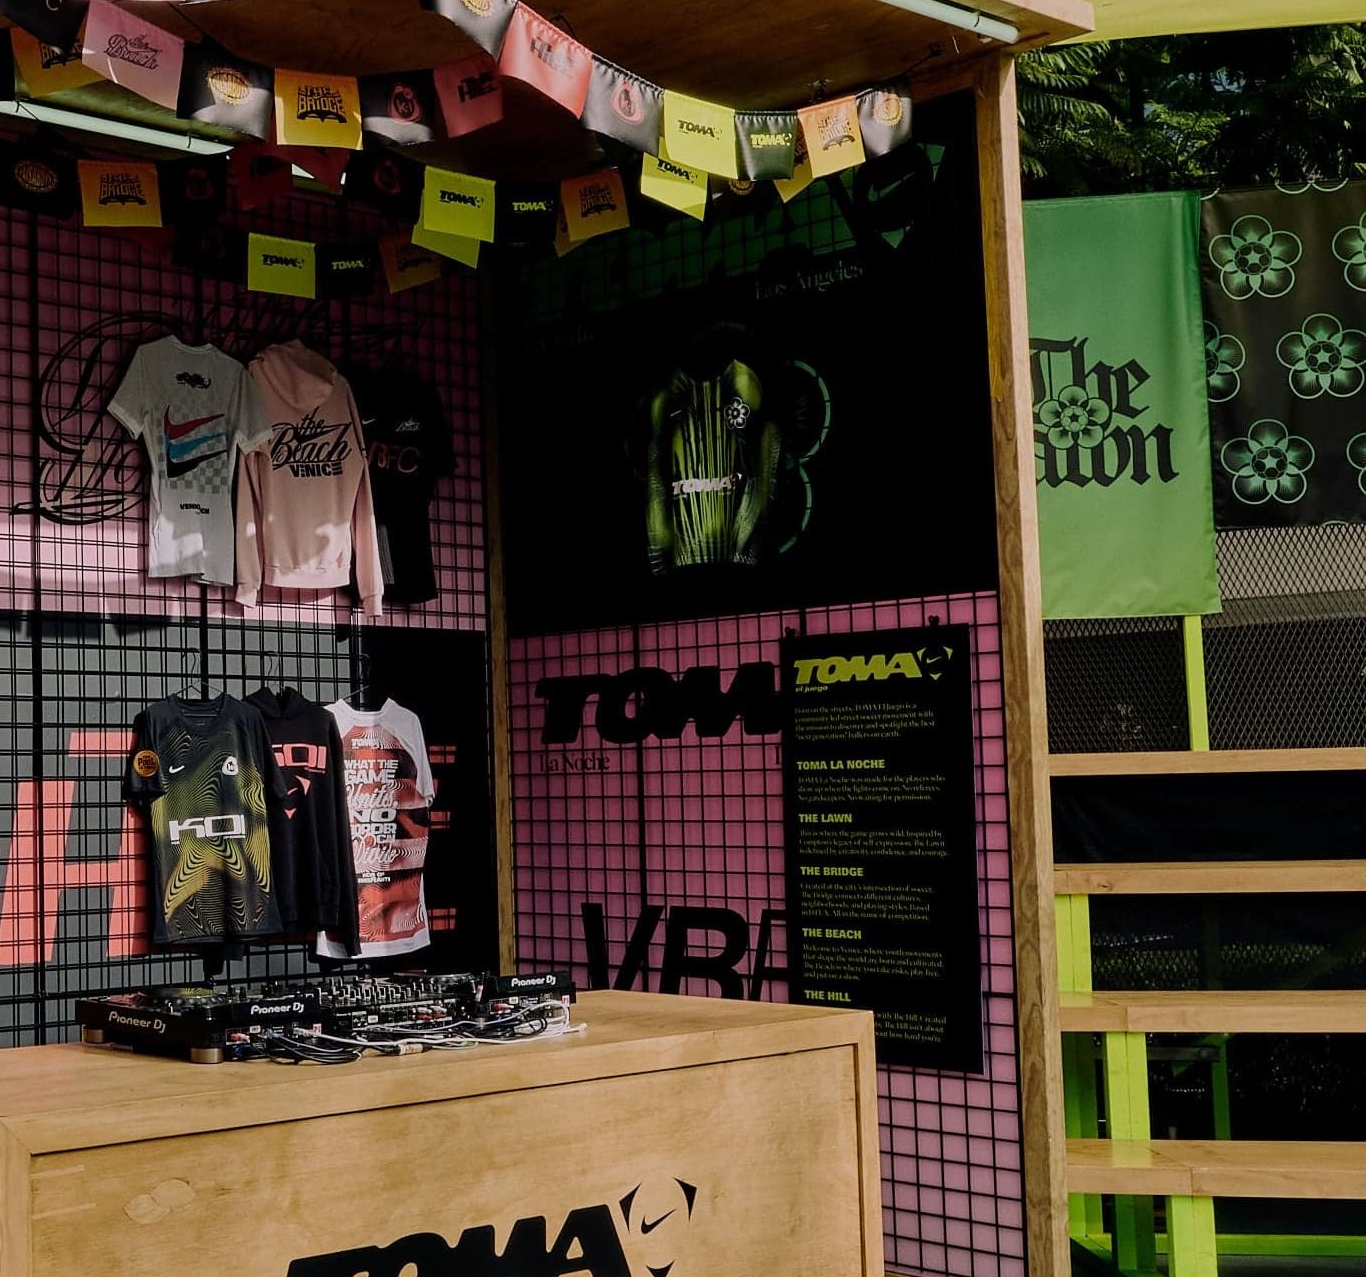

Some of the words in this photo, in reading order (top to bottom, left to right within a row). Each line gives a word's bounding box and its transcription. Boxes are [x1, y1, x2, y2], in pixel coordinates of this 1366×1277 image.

[296, 95, 346, 116] BRIDGE
[677, 119, 716, 138] TOMA
[749, 132, 785, 149] TOMA
[656, 158, 692, 181] TOMA
[440, 189, 476, 208] TOMA
[511, 200, 547, 212] TOMA
[261, 252, 298, 269] TOMA
[331, 258, 364, 270] TOMA
[269, 423, 354, 471] Beach
[289, 461, 344, 479] VENICE
[671, 475, 733, 495] TOMA
[793, 652, 923, 685] TOMA
[344, 758, 379, 770] WHAT
[379, 758, 400, 770] THE
[539, 753, 560, 773] La
[562, 751, 611, 773] Noche
[796, 760, 828, 771] TOMA
[829, 760, 845, 771] LA
[845, 758, 887, 770] NOCHE
[344, 769, 397, 785] GAME
[348, 808, 398, 824] NO
[798, 813, 819, 823] THE
[821, 813, 853, 824] LAWN
[168, 814, 246, 845] KOI
[800, 866, 821, 876] THE
[823, 866, 865, 877] BRIDGE
[802, 927, 823, 938] THE
[824, 928, 863, 940] BEACH
[511, 976, 545, 989] Pioneer
[804, 989, 825, 1001] THE
[826, 990, 852, 1002] HILL
[250, 1002, 291, 1017] Pioneer
[108, 1010, 153, 1030] Pioneer
